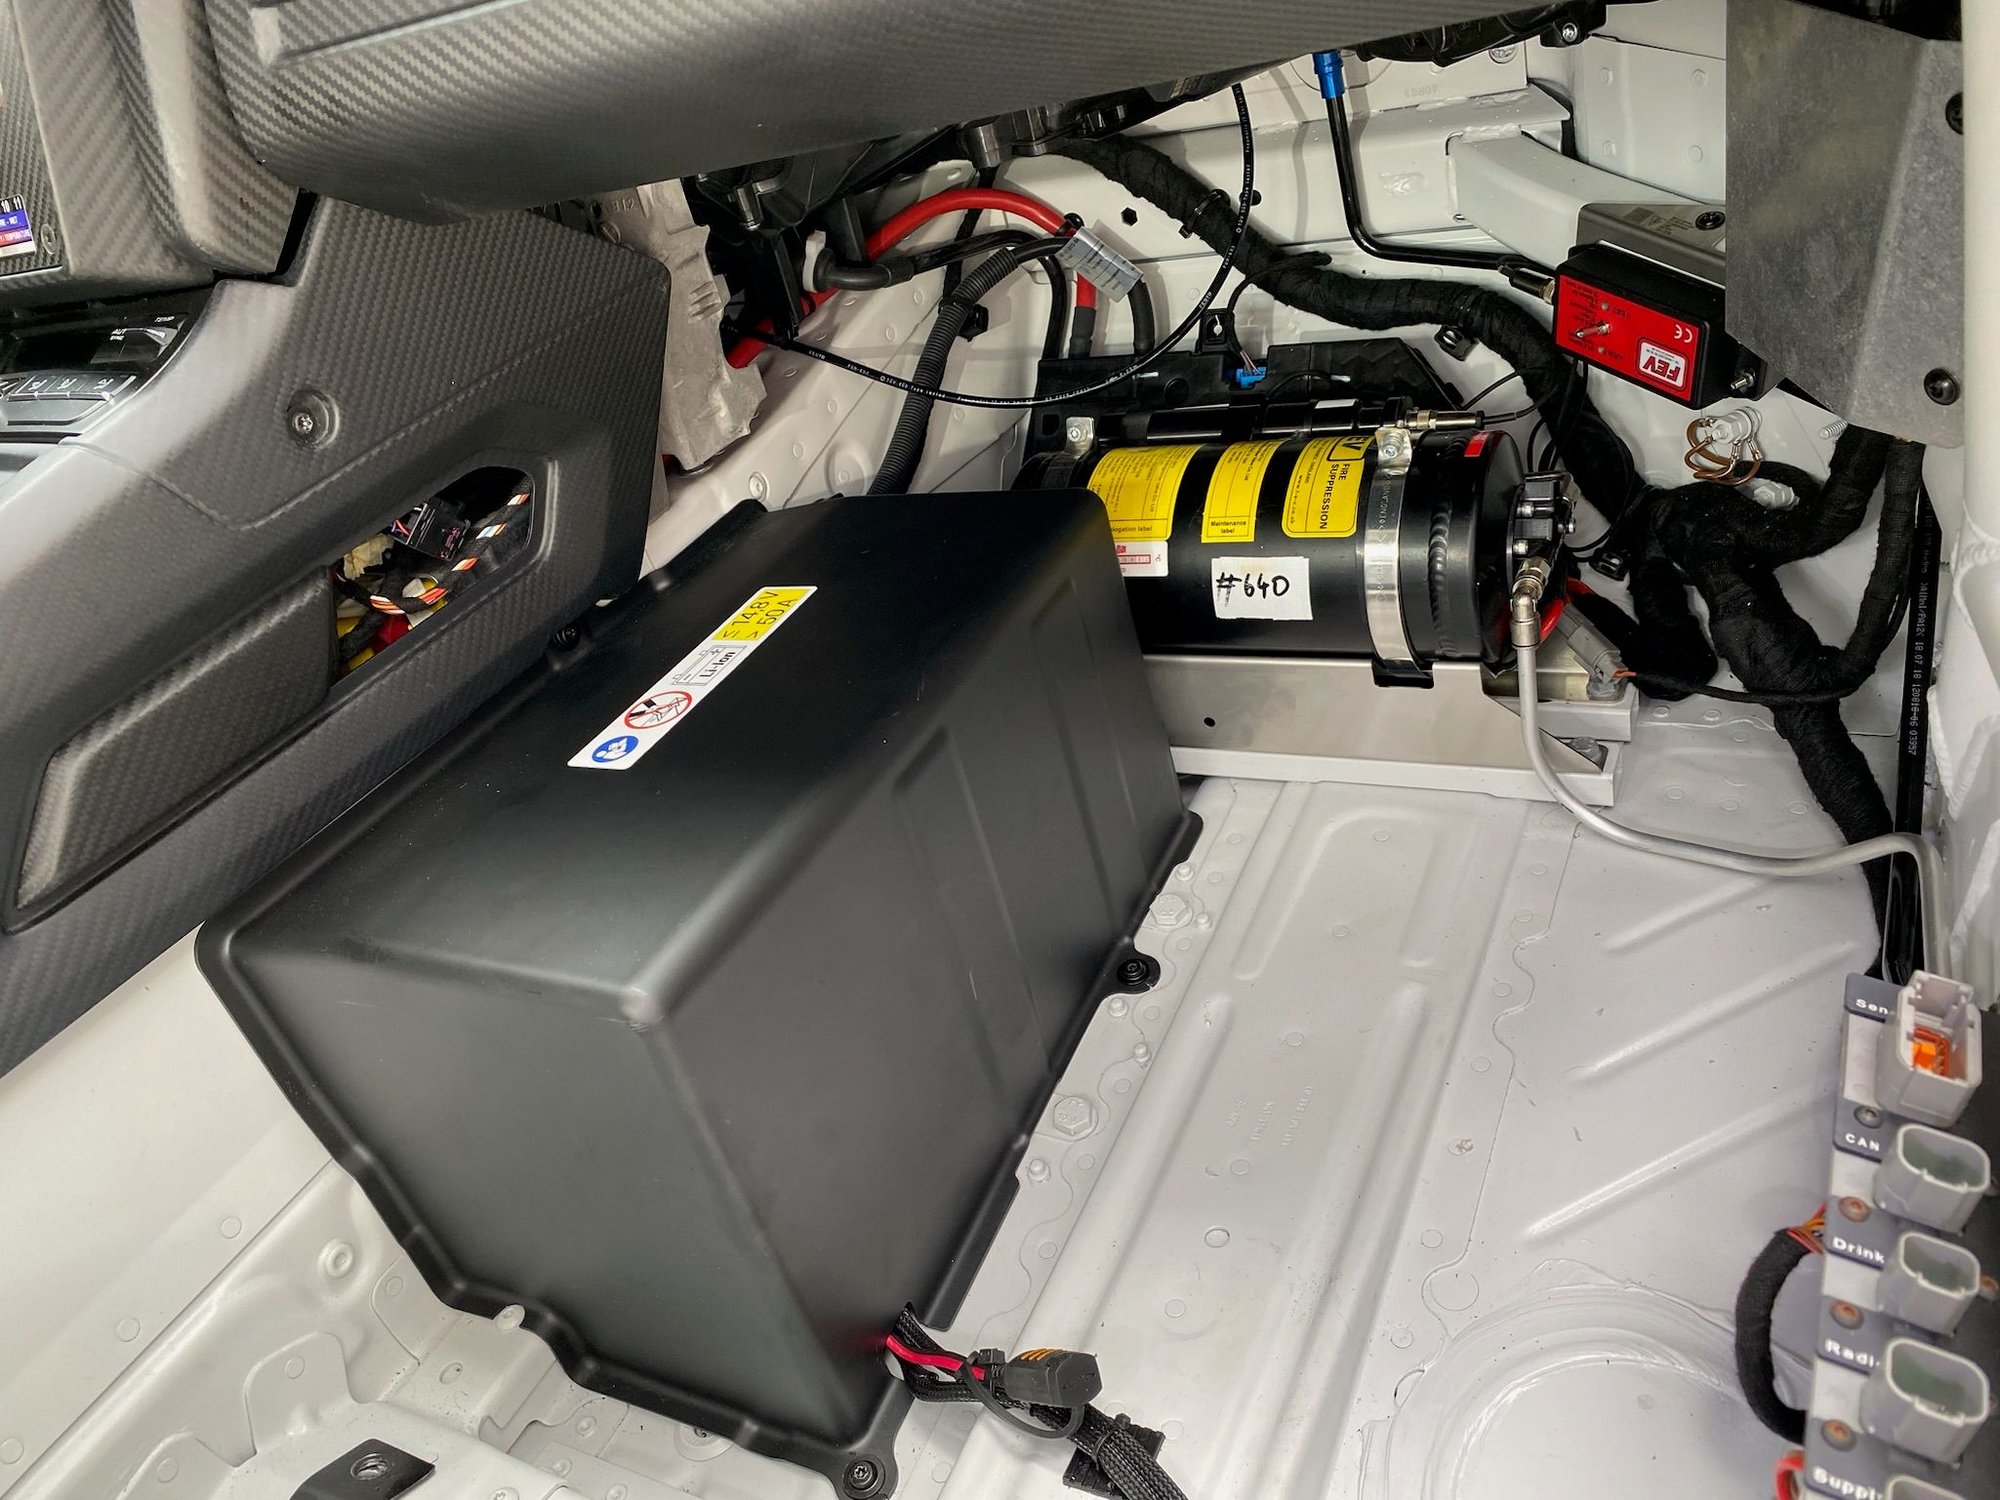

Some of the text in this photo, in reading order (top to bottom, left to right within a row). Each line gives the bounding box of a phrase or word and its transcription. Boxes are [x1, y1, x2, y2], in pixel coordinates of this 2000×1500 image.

[1644, 355, 1681, 382] FEV
[1338, 463, 1350, 481] FIRE
[1319, 463, 1340, 530] SUPPRESSION
[1210, 520, 1248, 528] Maintenance
[1216, 572, 1290, 607] #640
[700, 651, 736, 679] Li-Ion
[1844, 1132, 1881, 1152] CAN
[1825, 1339, 1880, 1368] Radi
[1812, 1466, 1883, 1500] Suppl
